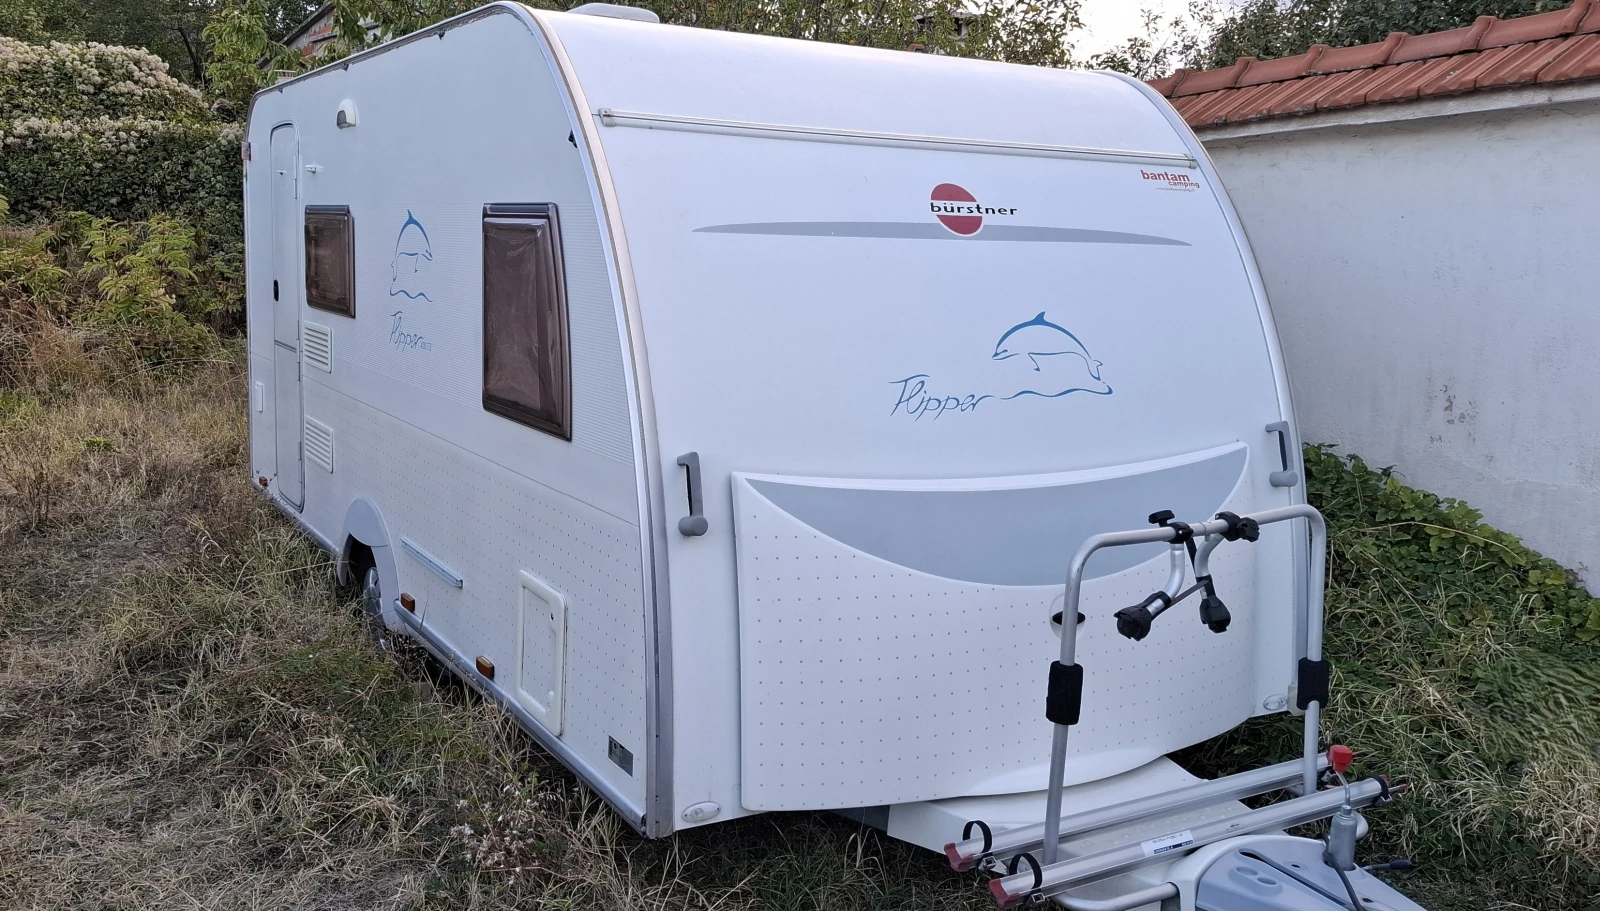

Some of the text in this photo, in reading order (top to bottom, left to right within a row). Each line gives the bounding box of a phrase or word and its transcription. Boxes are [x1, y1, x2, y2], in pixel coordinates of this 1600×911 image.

[1140, 169, 1190, 182] bantam
[1168, 180, 1200, 188] camping
[930, 202, 1018, 216] bürstner
[888, 374, 996, 421] Flipper
